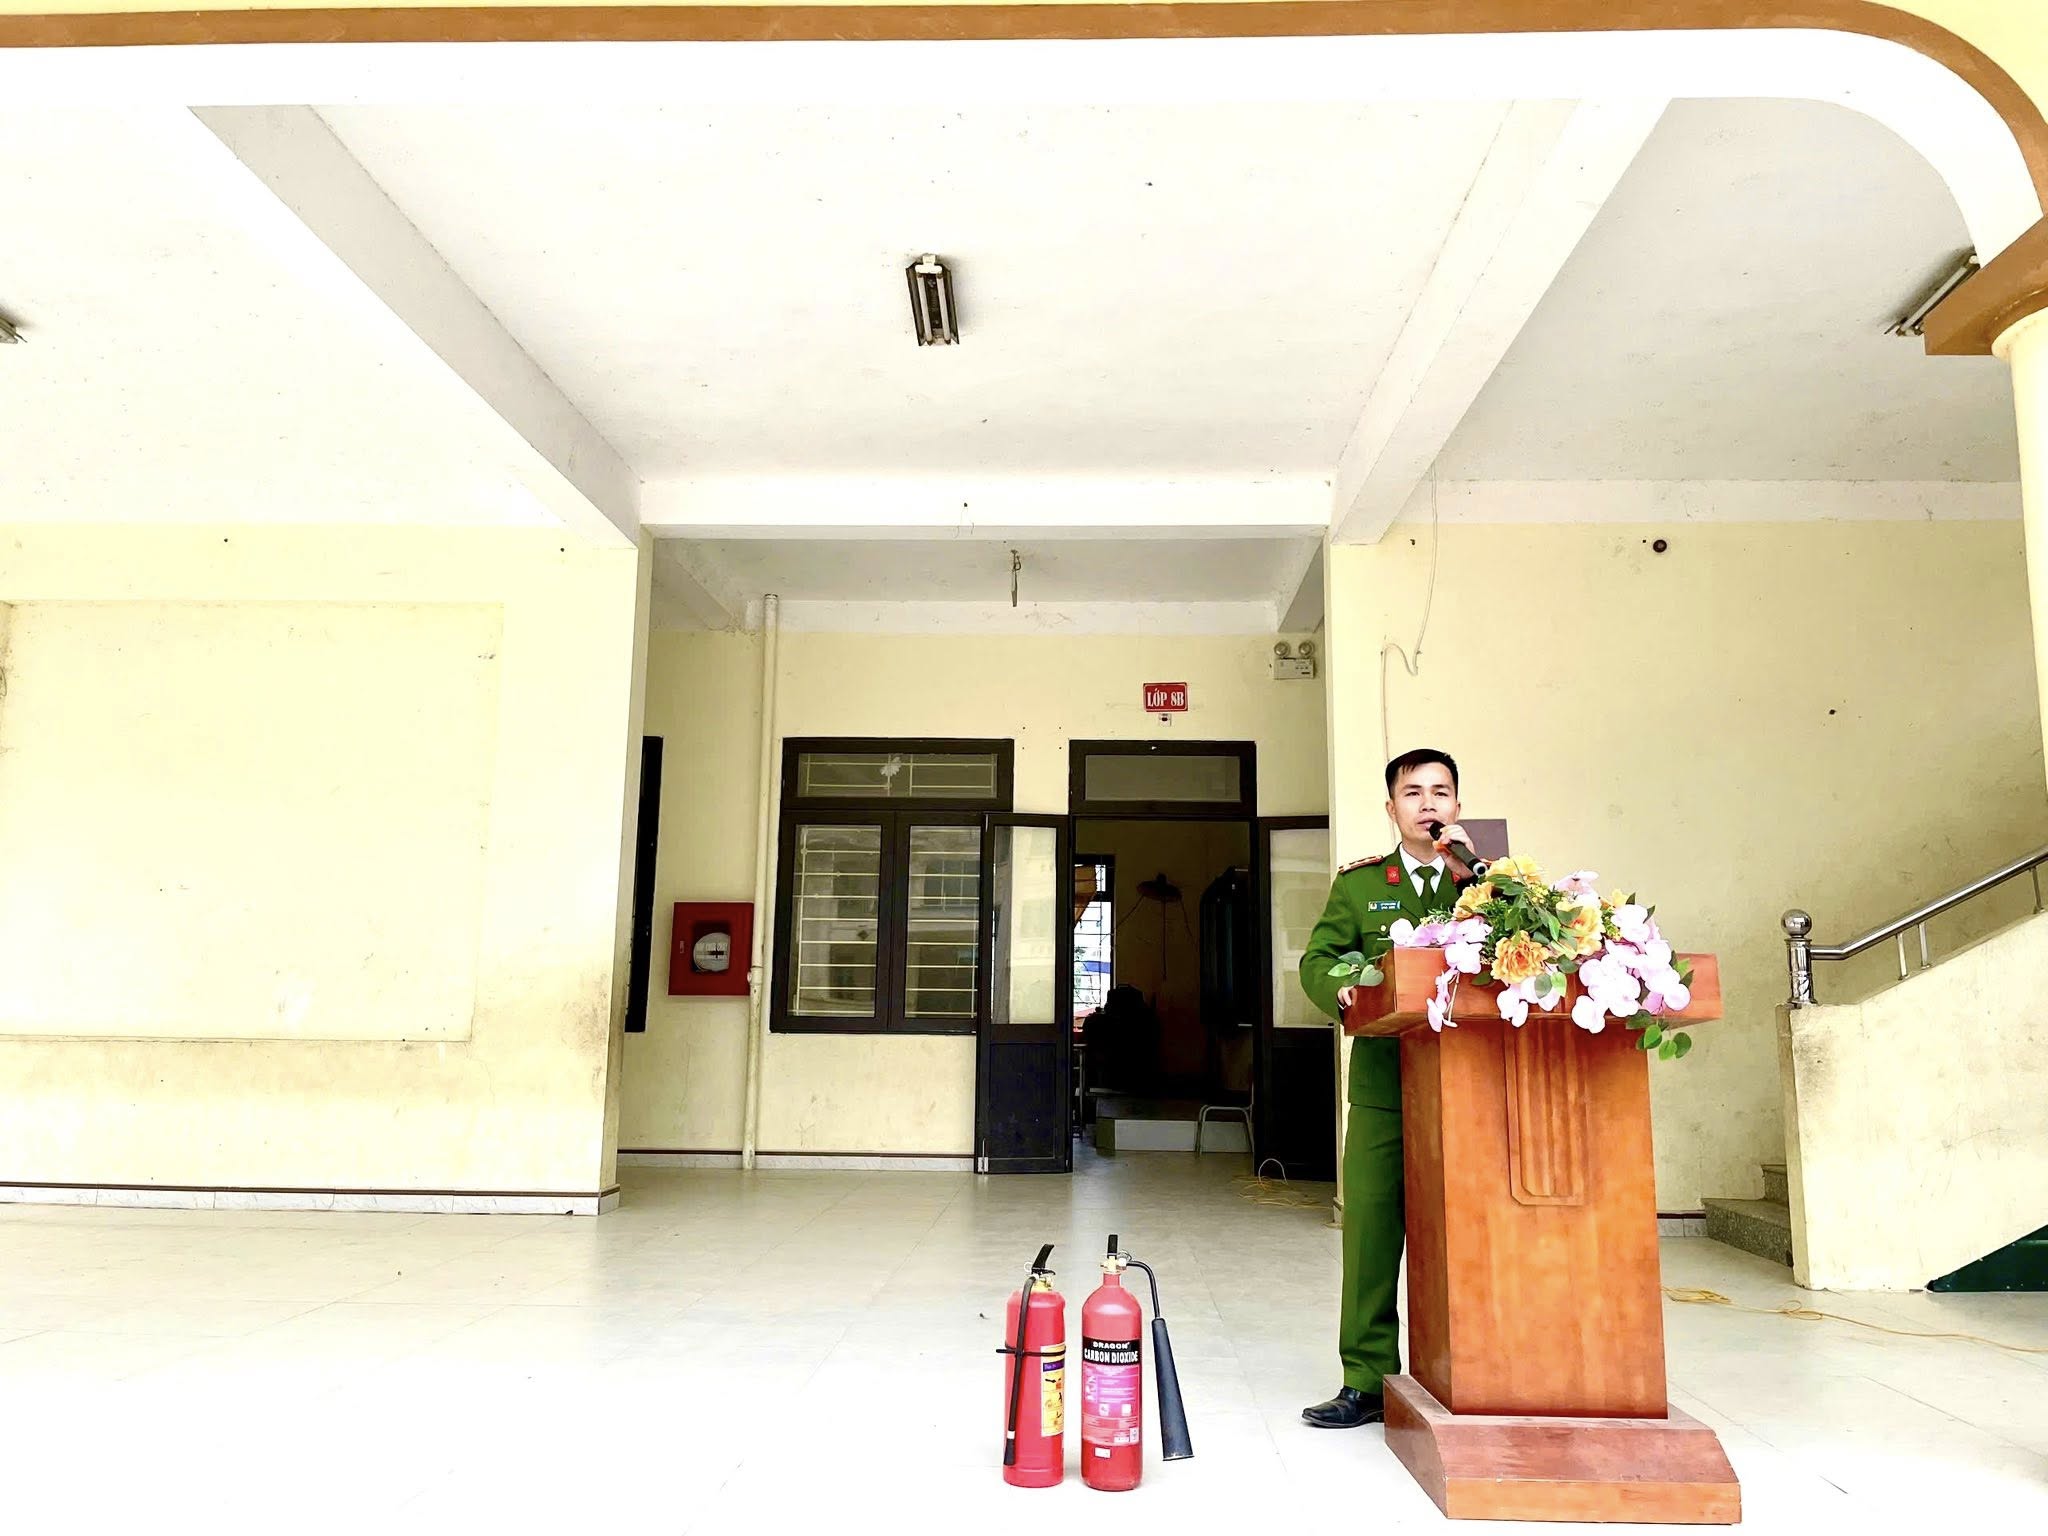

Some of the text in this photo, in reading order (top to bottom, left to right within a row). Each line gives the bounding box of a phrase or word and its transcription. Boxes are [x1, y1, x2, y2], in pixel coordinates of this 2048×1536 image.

[1171, 691, 1184, 707] 8B
[1093, 1341, 1129, 1349] DRAGON
[1084, 1348, 1138, 1363] CARBON DIOXIDE
